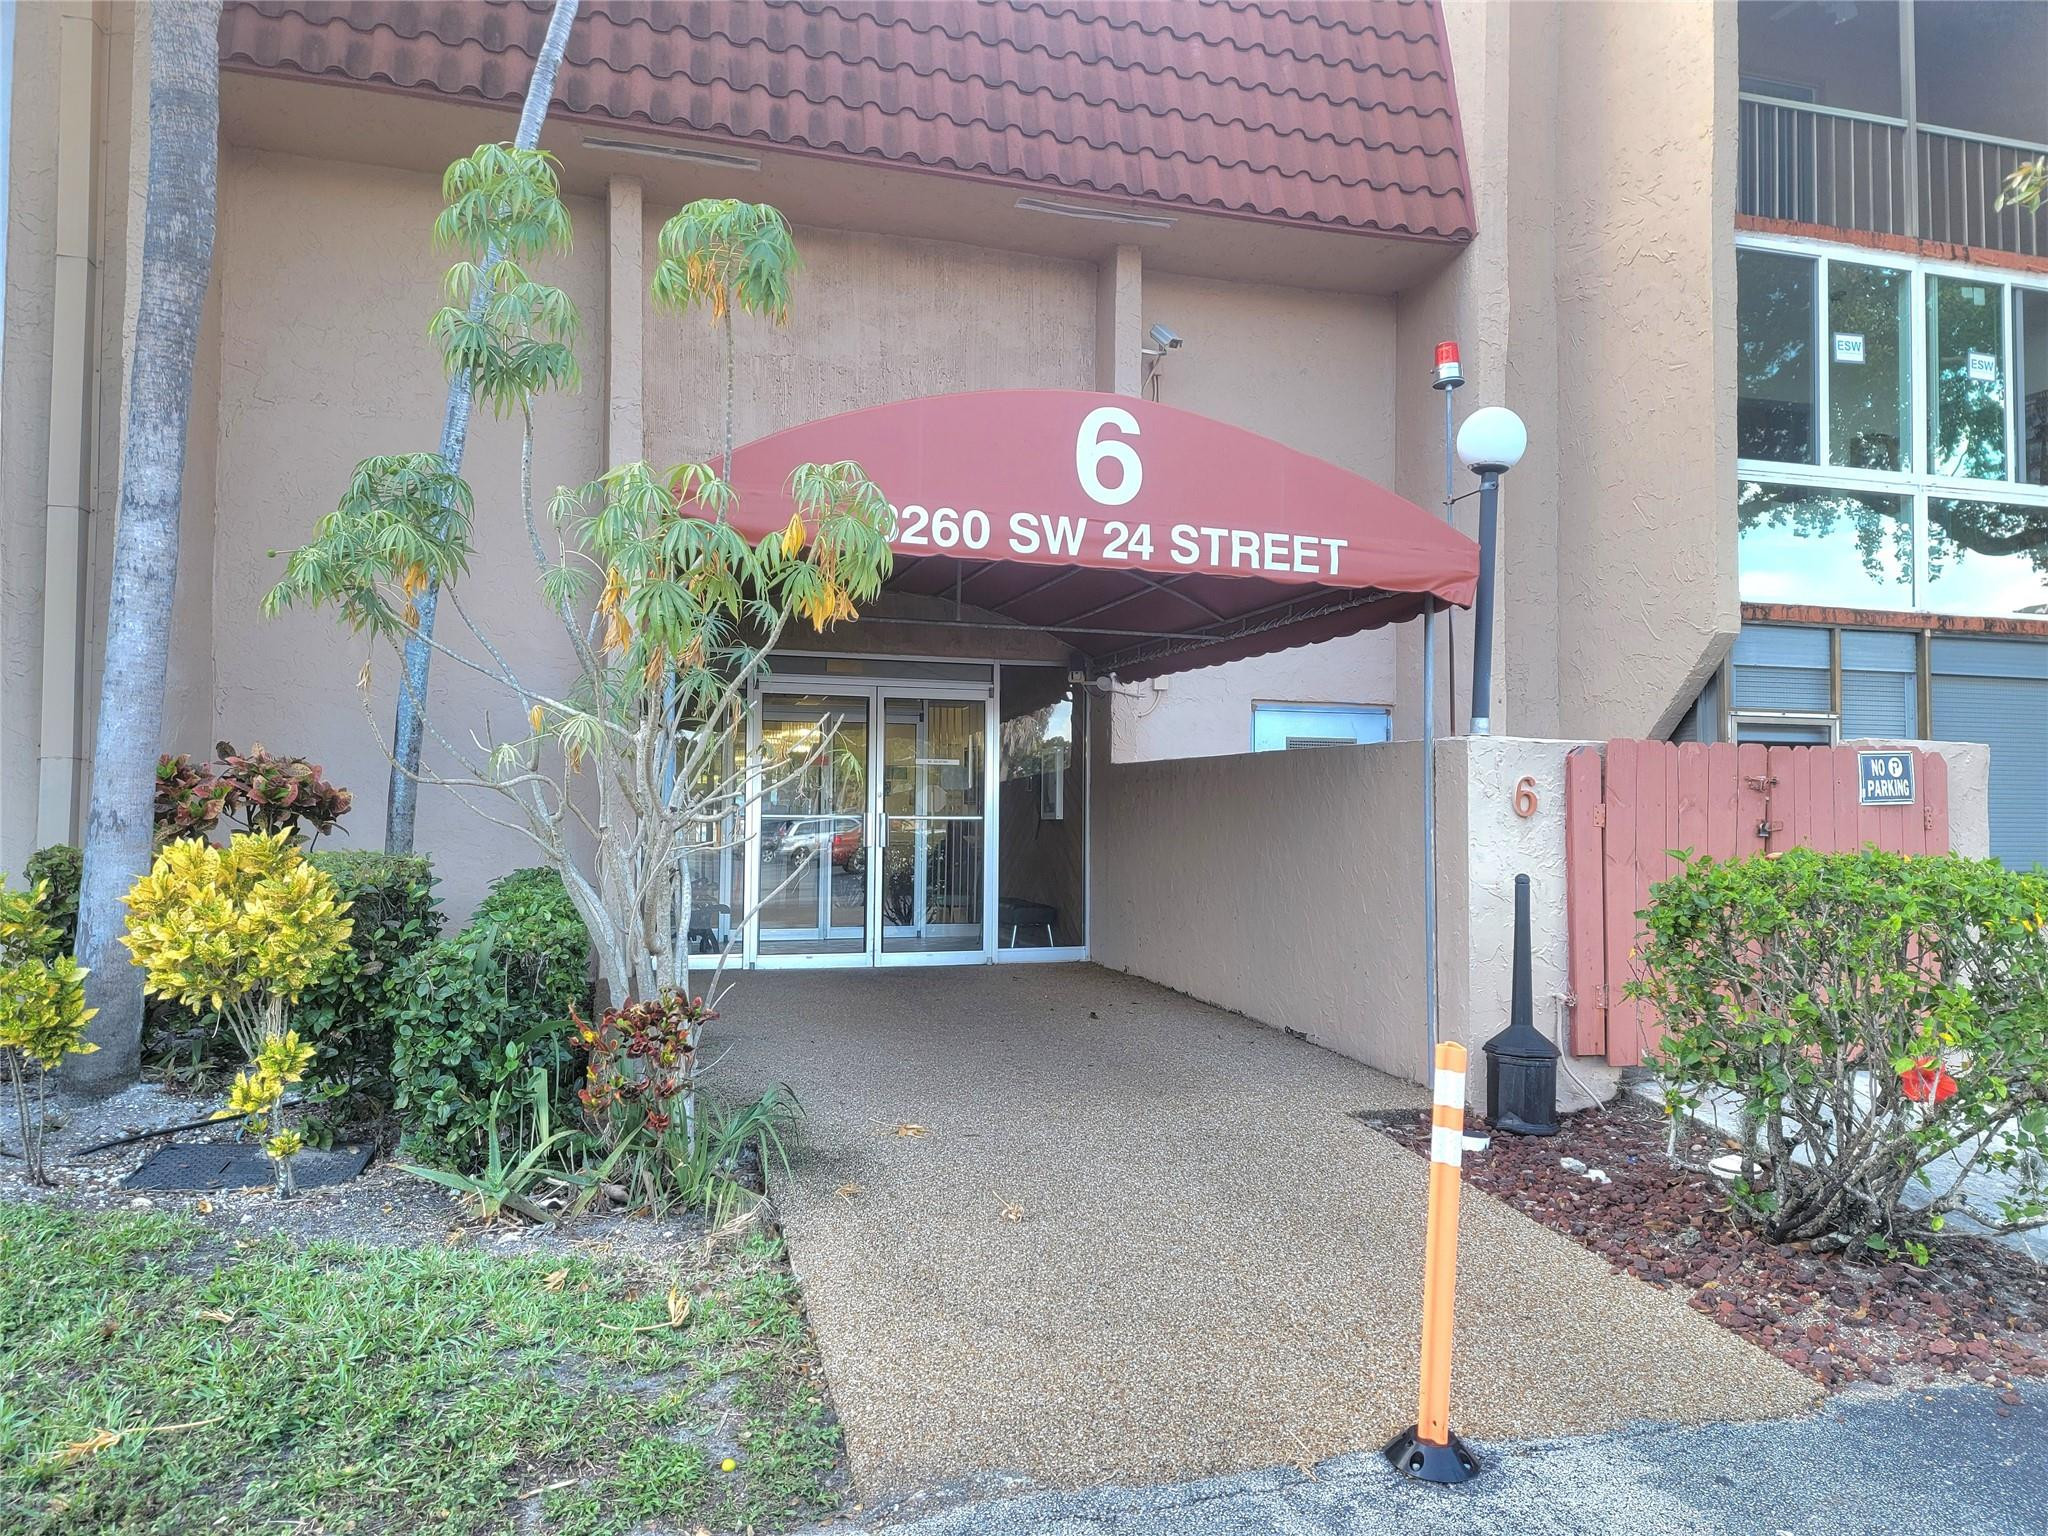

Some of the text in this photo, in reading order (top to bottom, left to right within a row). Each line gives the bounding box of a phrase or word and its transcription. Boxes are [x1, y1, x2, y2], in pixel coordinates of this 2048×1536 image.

[1837, 340, 1862, 352] ESW
[1971, 359, 1994, 371] ESW
[1076, 406, 1143, 506] 6
[1008, 512, 1087, 556] SW
[1102, 521, 1154, 561] 24
[1170, 524, 1348, 575] STREET
[1871, 759, 1885, 776] NO
[1514, 775, 1538, 818] 6
[1867, 778, 1909, 797] PARKING
